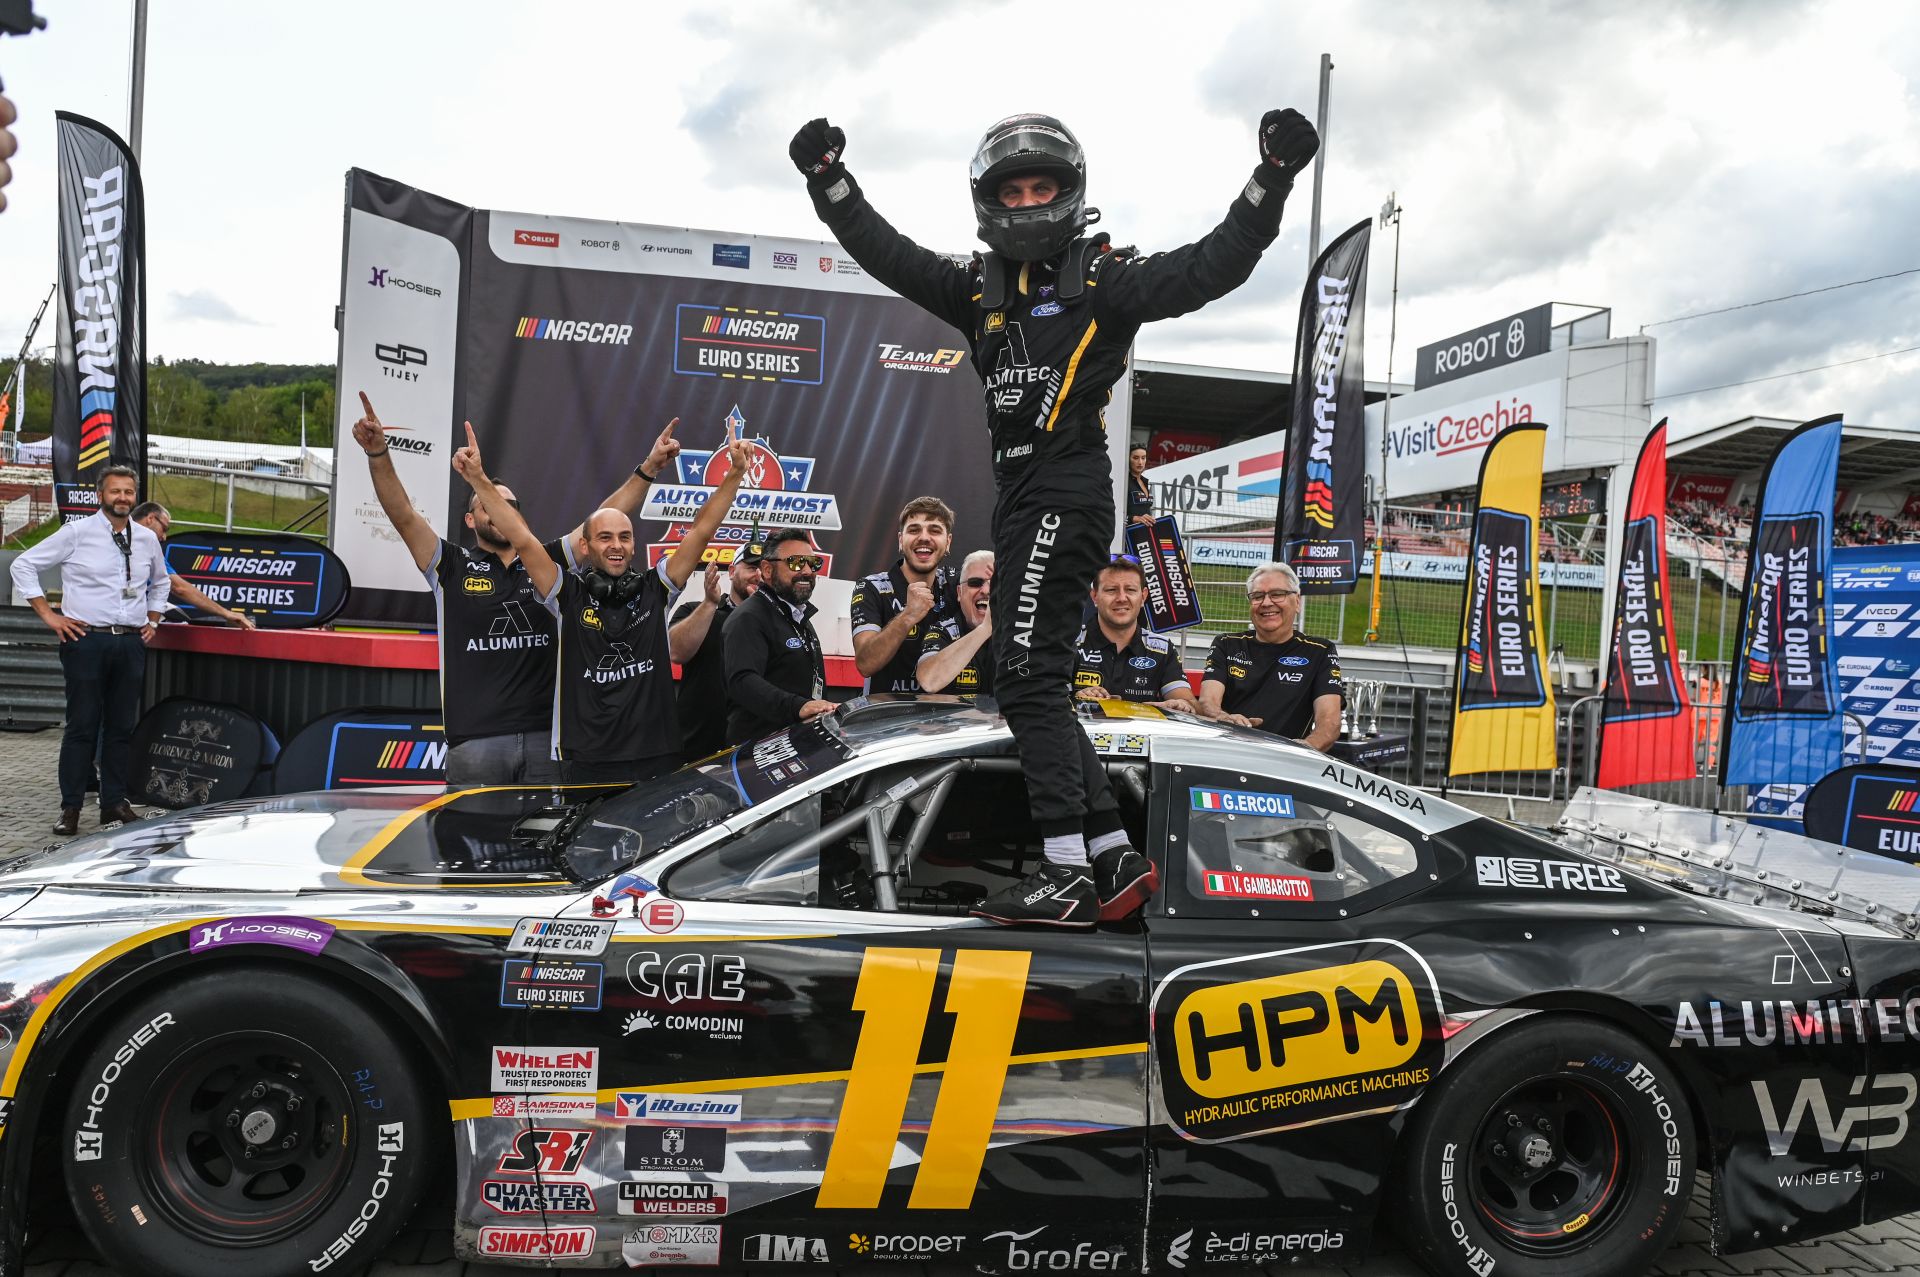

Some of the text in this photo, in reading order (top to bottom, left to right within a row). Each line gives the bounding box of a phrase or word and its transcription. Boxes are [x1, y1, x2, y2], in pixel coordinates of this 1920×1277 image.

[531, 235, 555, 244] ORLEN
[581, 239, 610, 249] ROBOT
[656, 246, 693, 255] HYUNDAI
[773, 254, 797, 264] NEXEN
[388, 276, 441, 298] HOOSIER
[544, 319, 633, 345] NASCAR
[725, 317, 800, 341] NASCAR
[699, 347, 800, 374] EURO SERIES
[1435, 332, 1501, 375] ROBOT
[382, 366, 419, 382] TIJEY
[884, 362, 951, 374] ORGANIZATION
[1176, 442, 1212, 454] ORLEN
[1160, 464, 1229, 516] MOST
[1697, 485, 1726, 495] ORLEN
[651, 488, 833, 513] AUTOOM MOST
[662, 506, 822, 525] NASCA CZECH REPUBLIC
[1216, 550, 1267, 560] HYUNDAI
[217, 557, 297, 577] NASCAR
[1315, 566, 1342, 578] SERIES
[1013, 512, 1062, 648] ALUMITEC
[1136, 540, 1168, 615] EURO SERIES
[1163, 554, 1190, 607] NASCAR
[236, 586, 295, 606] SERIES
[1496, 545, 1526, 676] EURO SERIES
[1784, 546, 1813, 687] EURO SERIES
[1866, 608, 1899, 616] IVECO
[466, 633, 550, 651] ALUMITEC
[1627, 629, 1659, 687] EURO
[1893, 703, 1920, 713] JOST
[1321, 764, 1427, 816] ALMASA
[1223, 793, 1291, 815] G.ERCOLI
[1023, 882, 1057, 906] sparco
[1231, 874, 1309, 898] V. GAMBAROTTO
[649, 904, 675, 926] E
[229, 924, 322, 944] HOOSIER
[545, 921, 600, 938] NASCAR
[523, 937, 594, 950] RACE CAR
[536, 967, 586, 982] NASCAR
[625, 951, 746, 1005] CAE
[517, 988, 585, 1004] EURO SERIES
[665, 1015, 744, 1033] COMODINI
[1188, 976, 1409, 1082] HPM
[709, 1032, 742, 1041] exclusive
[495, 1050, 594, 1069] WHELEN
[82, 1011, 177, 1129] HOOSIER
[500, 1070, 592, 1080] TRUSTED TO PROTECT
[815, 946, 1032, 1211] 11
[505, 1079, 587, 1088] FIRST RESPONDERS
[517, 1101, 596, 1109] SAMSONAS
[648, 1099, 740, 1115] iRacing
[1184, 1067, 1430, 1127] HYDRAULIC PERFORMANCE MACHINES
[1644, 1084, 1681, 1197] HOOSIER
[640, 1156, 704, 1166] STROM
[484, 1183, 586, 1203] QUARTER
[624, 1184, 708, 1200] LINCOLN
[1440, 1142, 1477, 1258] HOOSIER
[307, 1154, 398, 1274] HOOSIER
[502, 1197, 594, 1213] MASTER
[642, 1201, 716, 1214] WELDERS
[1565, 1214, 1588, 1231] Bassett
[486, 1232, 586, 1255] SIMPSON
[1205, 1228, 1344, 1253] è-di energia
[873, 1253, 901, 1261] beauty
[1007, 1241, 1128, 1270] brofer
[1204, 1253, 1232, 1263] LUCE
[1252, 1252, 1279, 1262] GAS
